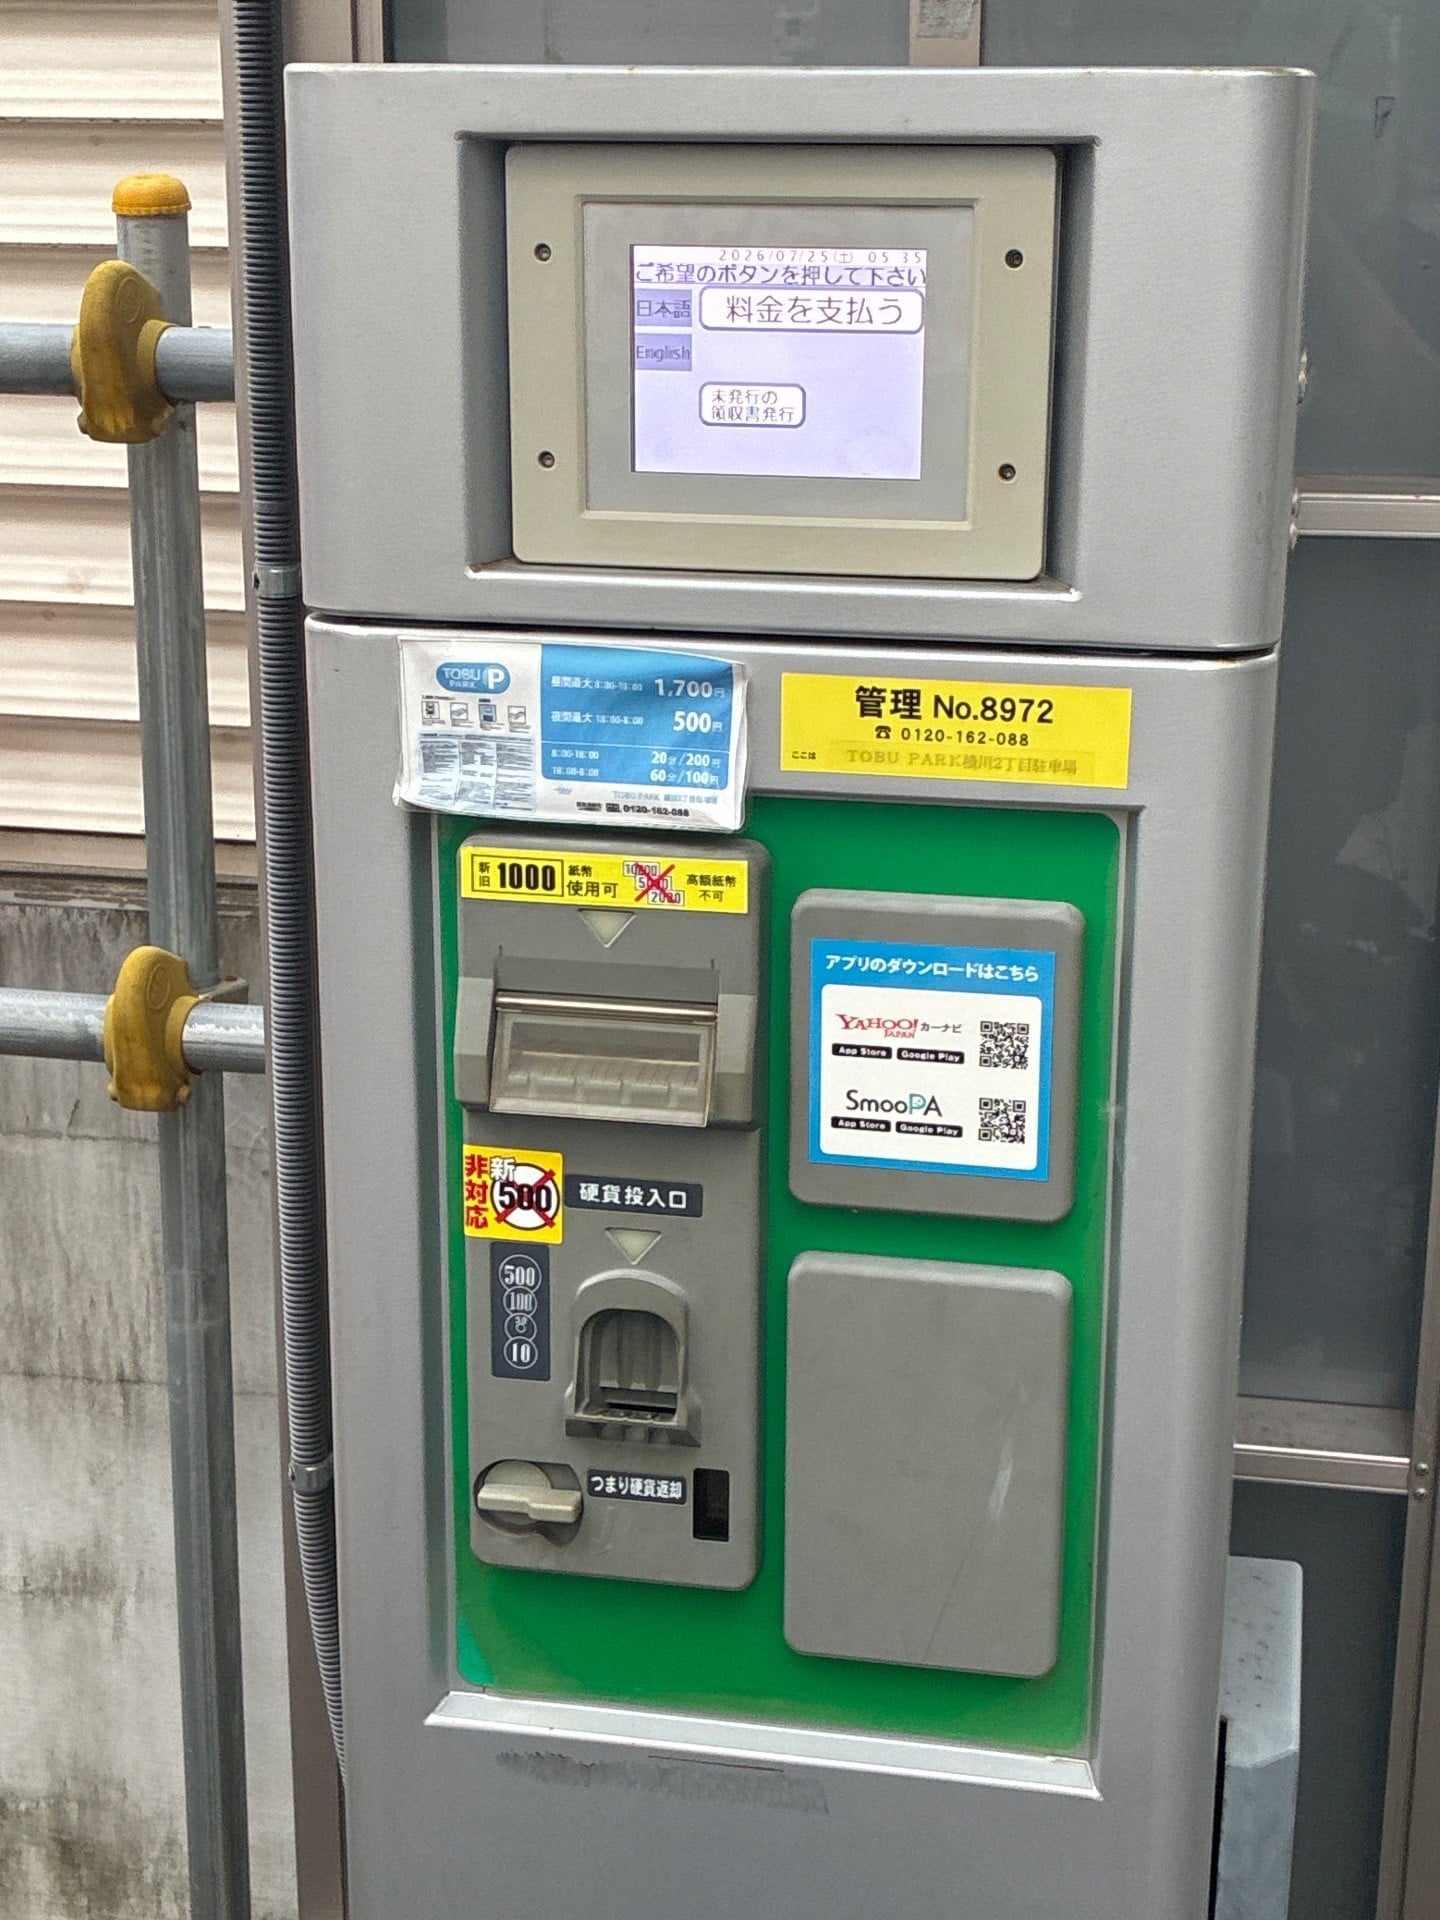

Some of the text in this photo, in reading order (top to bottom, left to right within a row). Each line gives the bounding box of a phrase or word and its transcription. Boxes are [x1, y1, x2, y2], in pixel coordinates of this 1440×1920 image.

[636, 262, 926, 287] ご希望のボタンを押して下さい
[637, 299, 691, 319] 日本語
[726, 295, 903, 325] 料金を支払う
[636, 345, 690, 362] English
[442, 668, 480, 681] TOBU
[487, 668, 505, 689] P
[654, 678, 726, 698] 1,700円
[855, 685, 1055, 724] 管理 No.8972
[673, 711, 722, 732] 500円
[900, 728, 1029, 747] 0120-162-088
[791, 751, 817, 761] ここは
[846, 749, 900, 765] TOBU
[497, 862, 556, 891] 1000
[568, 864, 593, 878] 紙幣
[687, 874, 737, 888] 高額紙幣
[566, 880, 618, 898] 使用可
[699, 890, 724, 902] 不可
[825, 954, 1040, 983] アプリのダウンロードはこちら
[920, 1022, 962, 1034] カーナビ
[838, 1046, 887, 1057] App Store
[901, 1050, 961, 1063] Google Play
[846, 1089, 943, 1118] SmooPA
[838, 1119, 886, 1130] App Store
[900, 1123, 959, 1136] Google Play
[490, 1155, 517, 1182] 新
[465, 1154, 489, 1229] 非対応
[498, 1182, 553, 1213] 500
[579, 1182, 687, 1209] 硬貨投入口
[503, 1265, 535, 1287] 500
[510, 1292, 533, 1312] 100
[512, 1343, 531, 1364] 10
[590, 1476, 683, 1500] つまり硬貨返却
